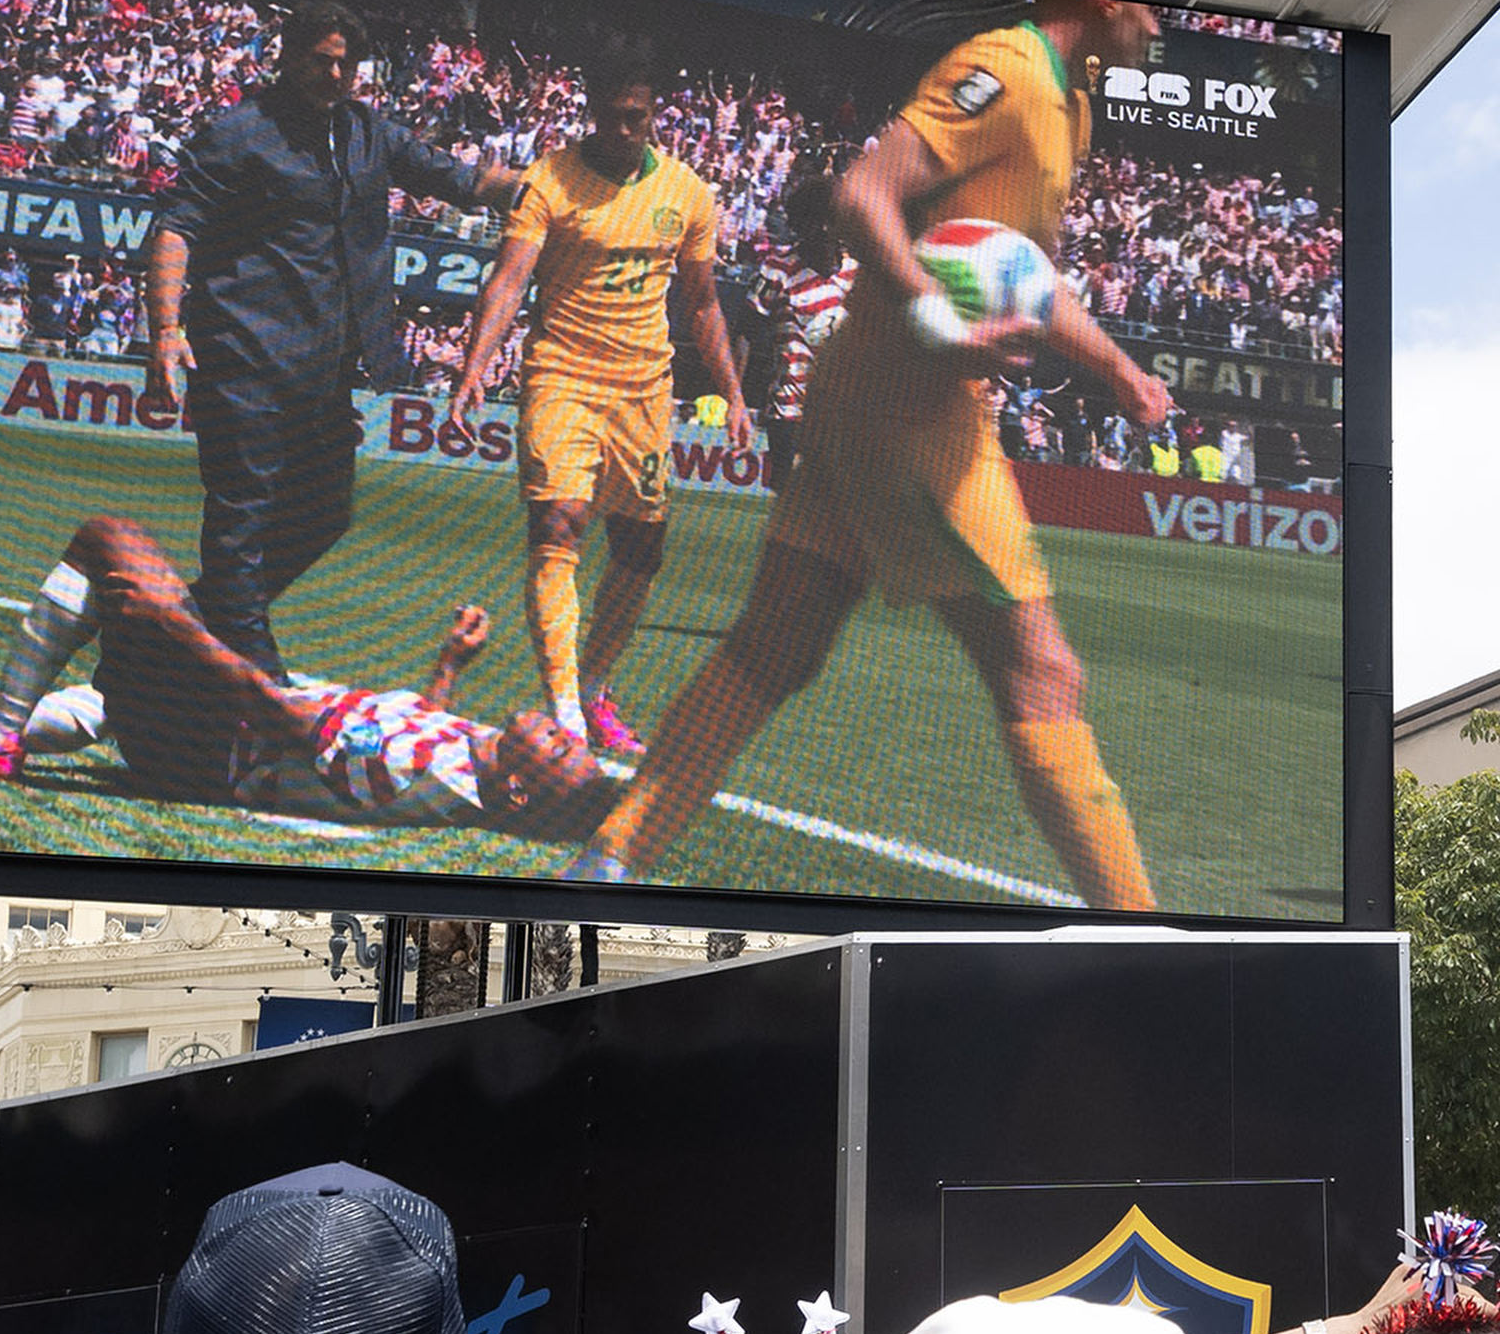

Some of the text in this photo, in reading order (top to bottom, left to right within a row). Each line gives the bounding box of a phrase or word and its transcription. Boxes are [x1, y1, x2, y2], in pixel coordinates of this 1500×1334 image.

[1204, 78, 1277, 119] FOX
[1106, 103, 1153, 126] LIVE
[1167, 110, 1259, 139] SEATTLE
